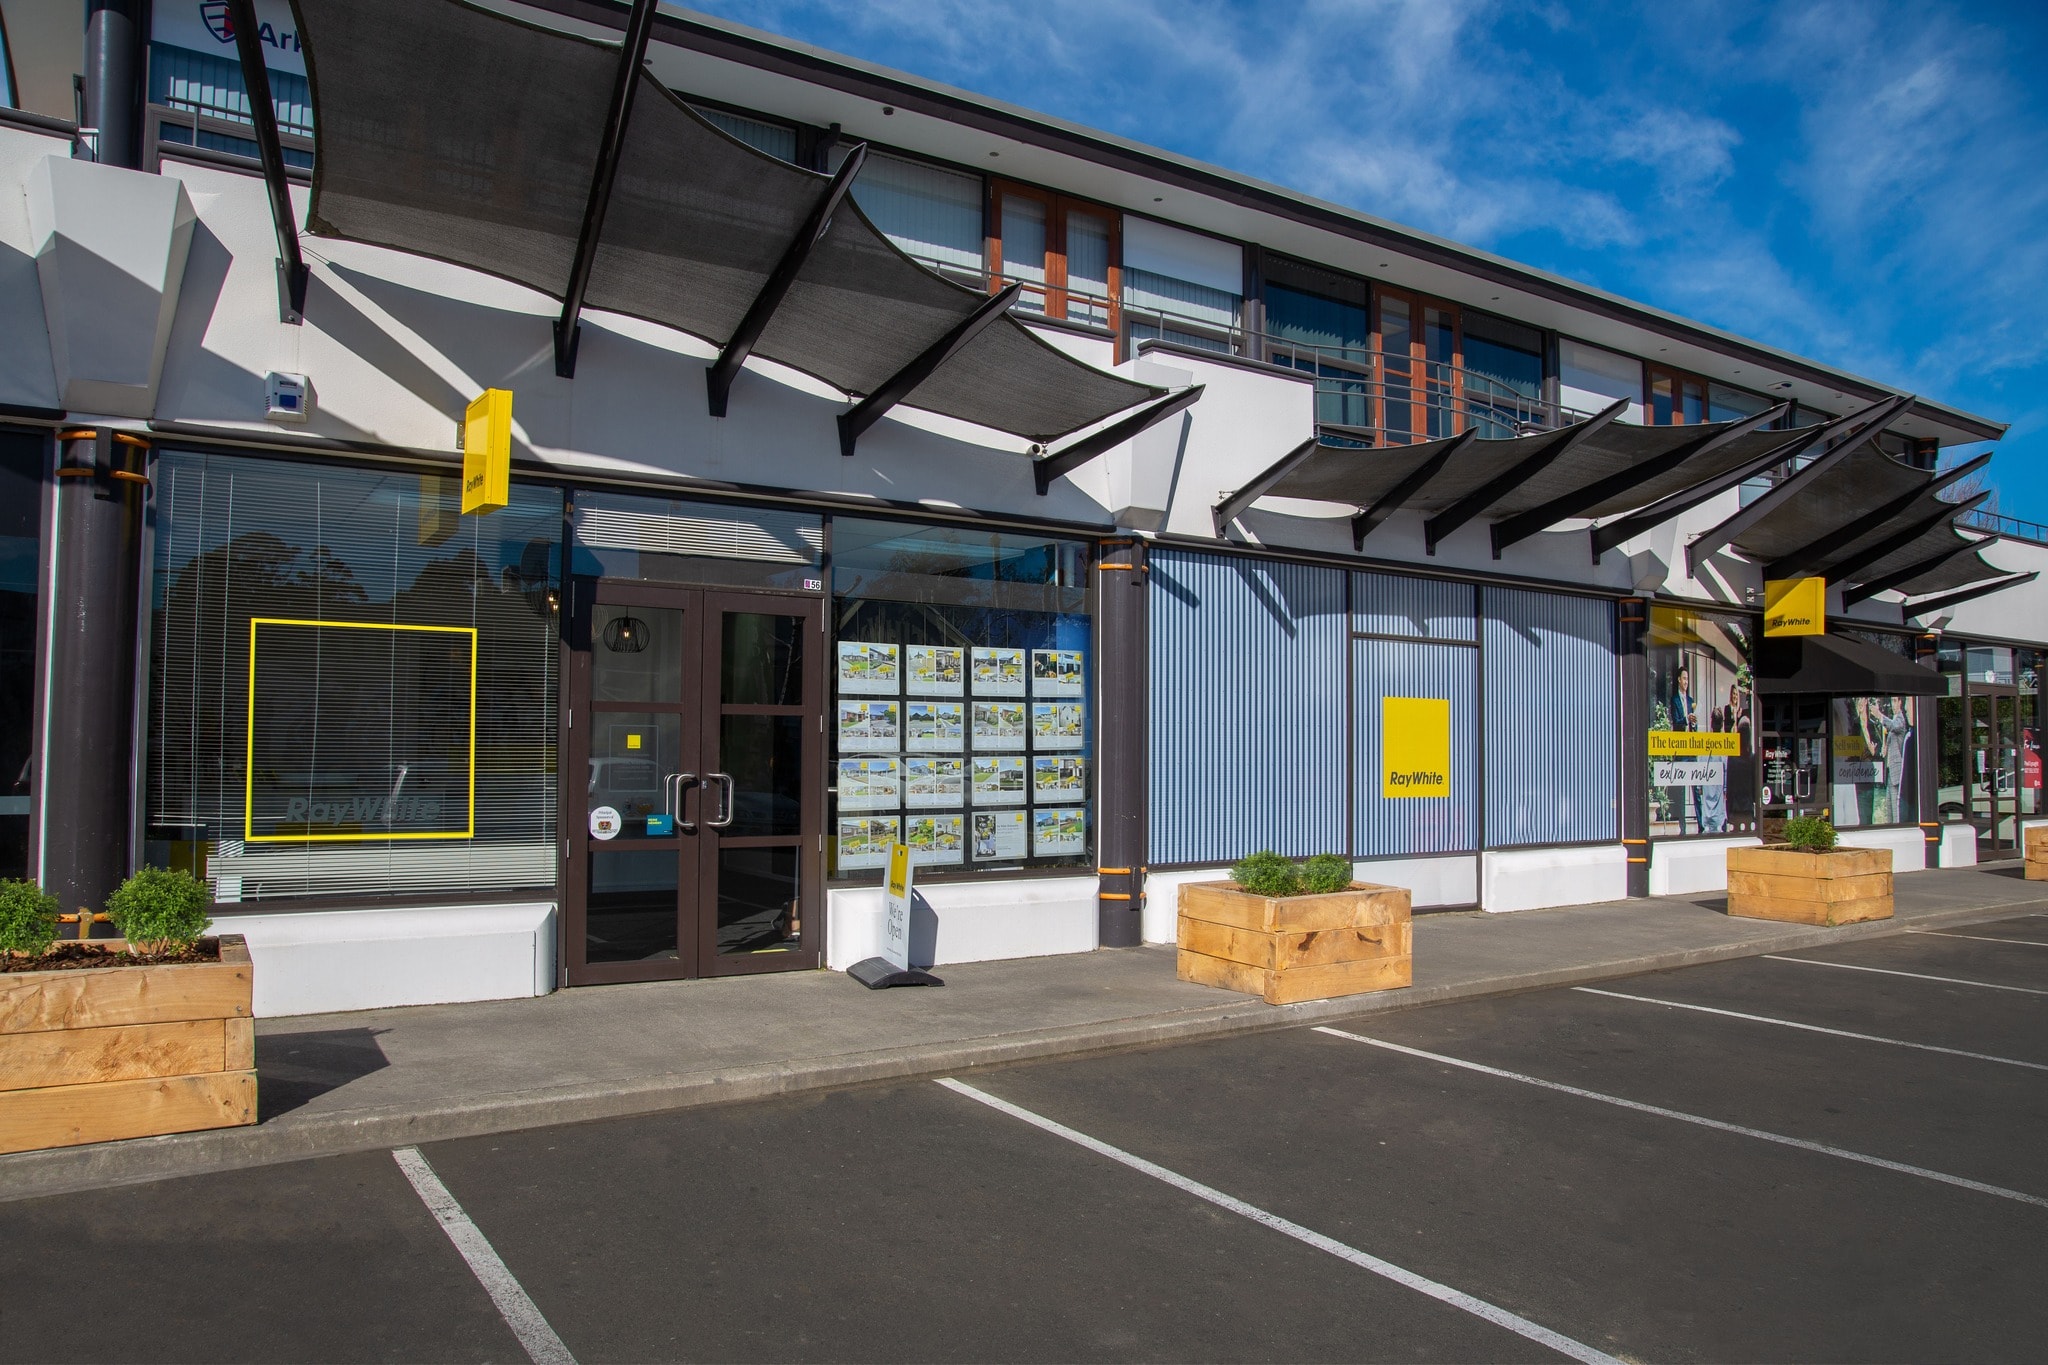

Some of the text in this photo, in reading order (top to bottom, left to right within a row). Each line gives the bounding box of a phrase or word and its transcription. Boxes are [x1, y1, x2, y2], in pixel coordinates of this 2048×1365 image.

[1651, 736, 1735, 752] The team that goes the
[1660, 750, 1717, 784] extra mile
[1390, 771, 1443, 788] RayWhite
[285, 797, 441, 827] RayWhite
[887, 918, 902, 941] Open
